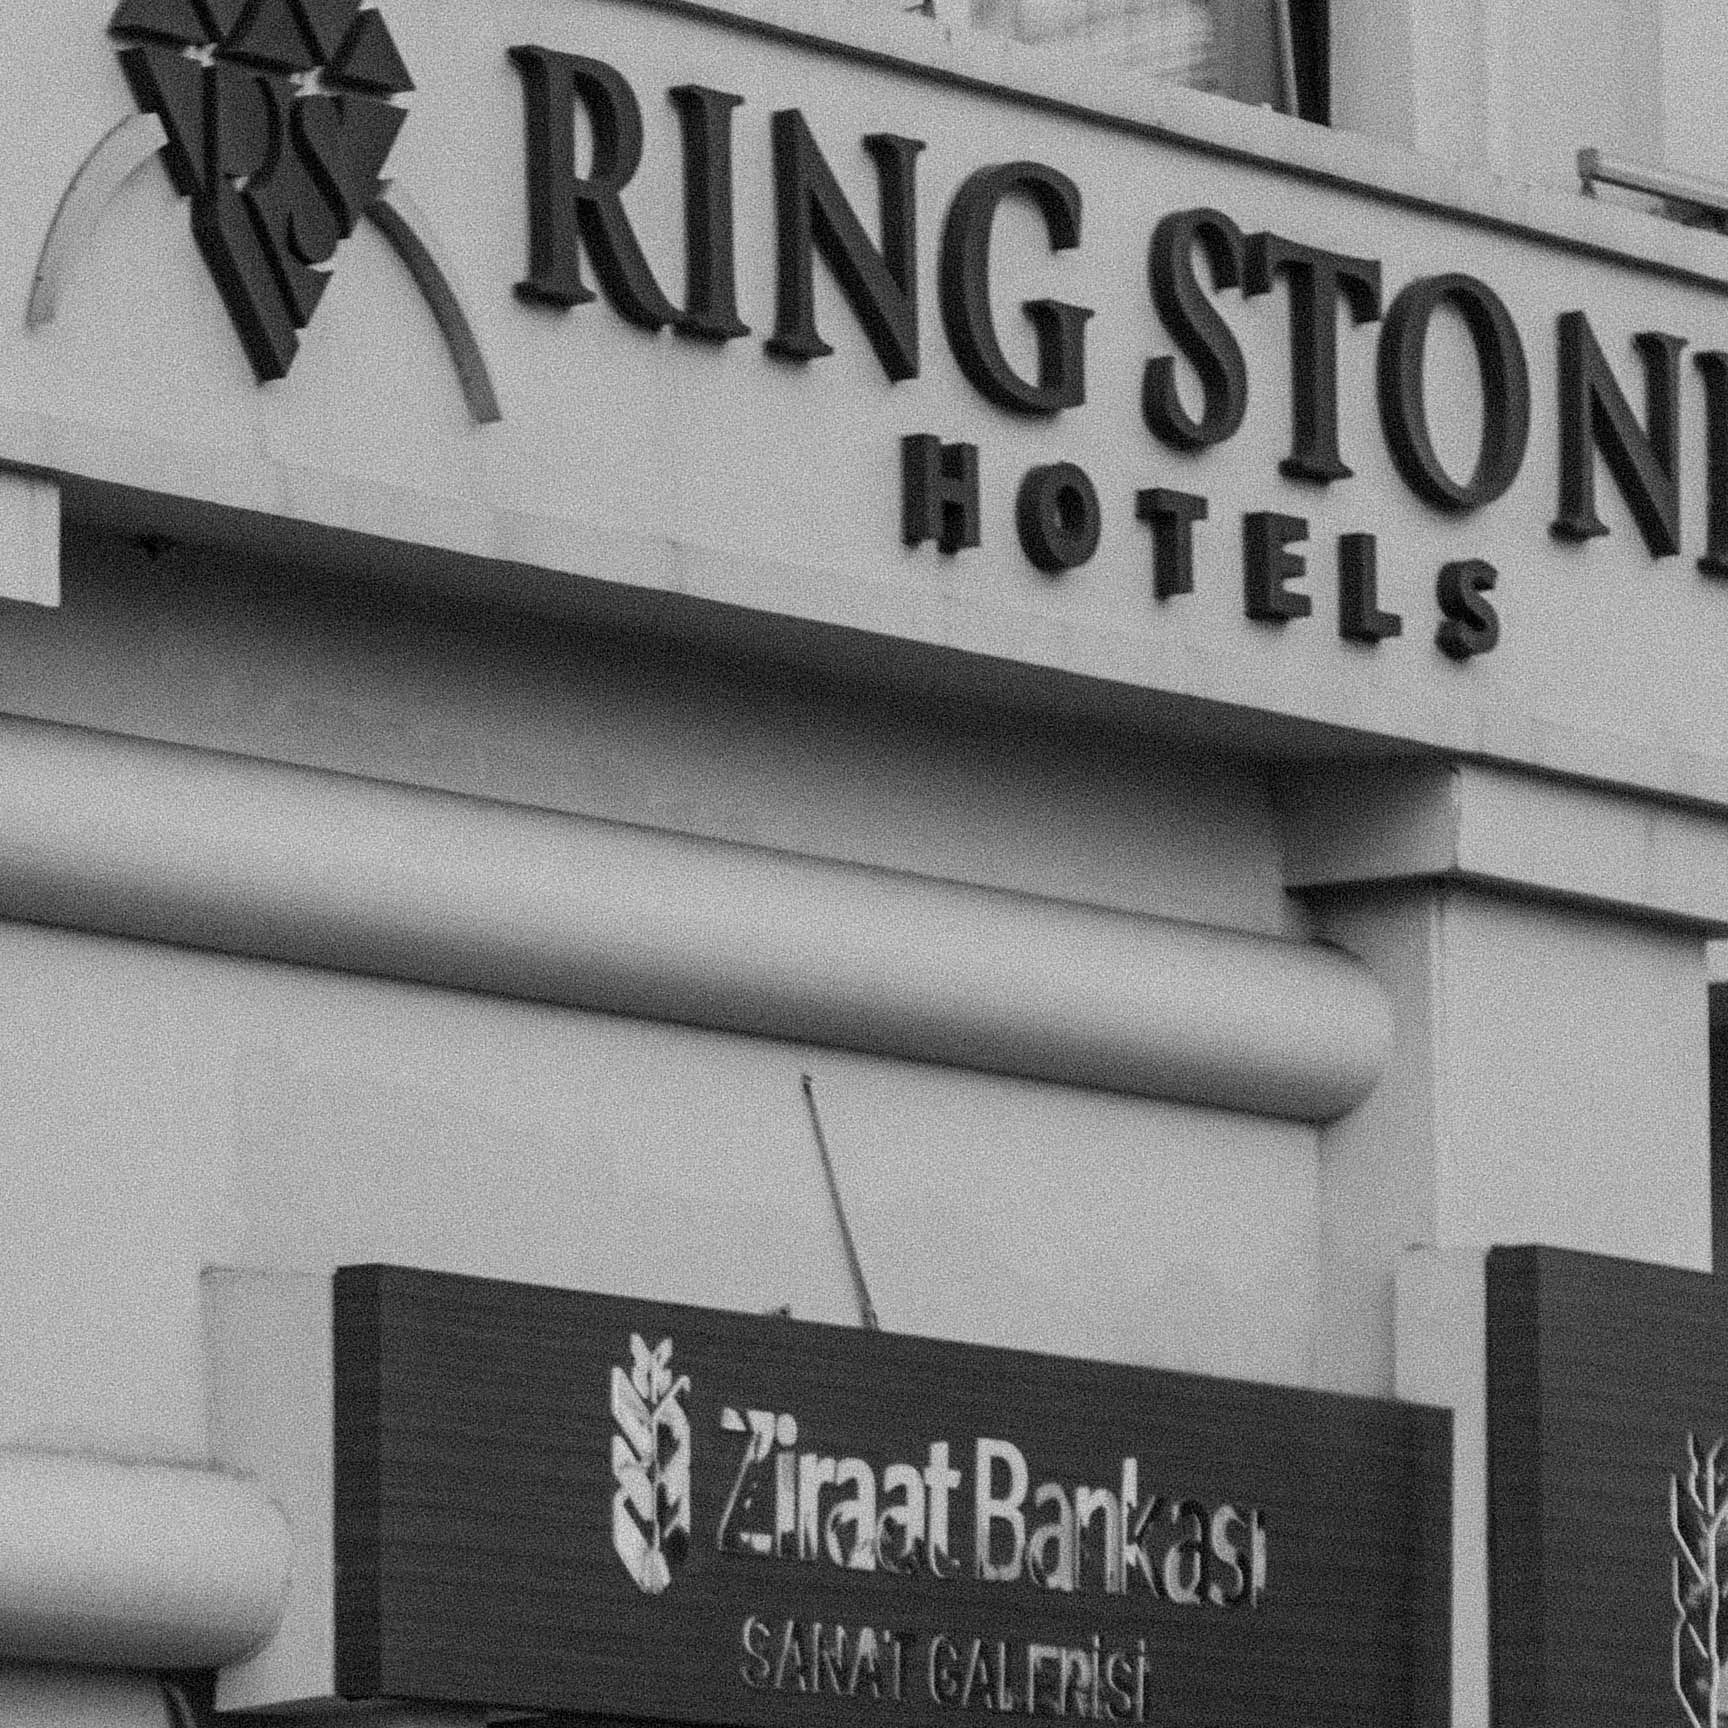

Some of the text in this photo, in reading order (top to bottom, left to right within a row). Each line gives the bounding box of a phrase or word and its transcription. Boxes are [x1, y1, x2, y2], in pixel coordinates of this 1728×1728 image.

[506, 43, 1094, 415] RING
[899, 433, 1501, 660] HOTELS
[716, 1406, 1268, 1609] Ziraat Bankası
[741, 1615, 916, 1702] SANAT
